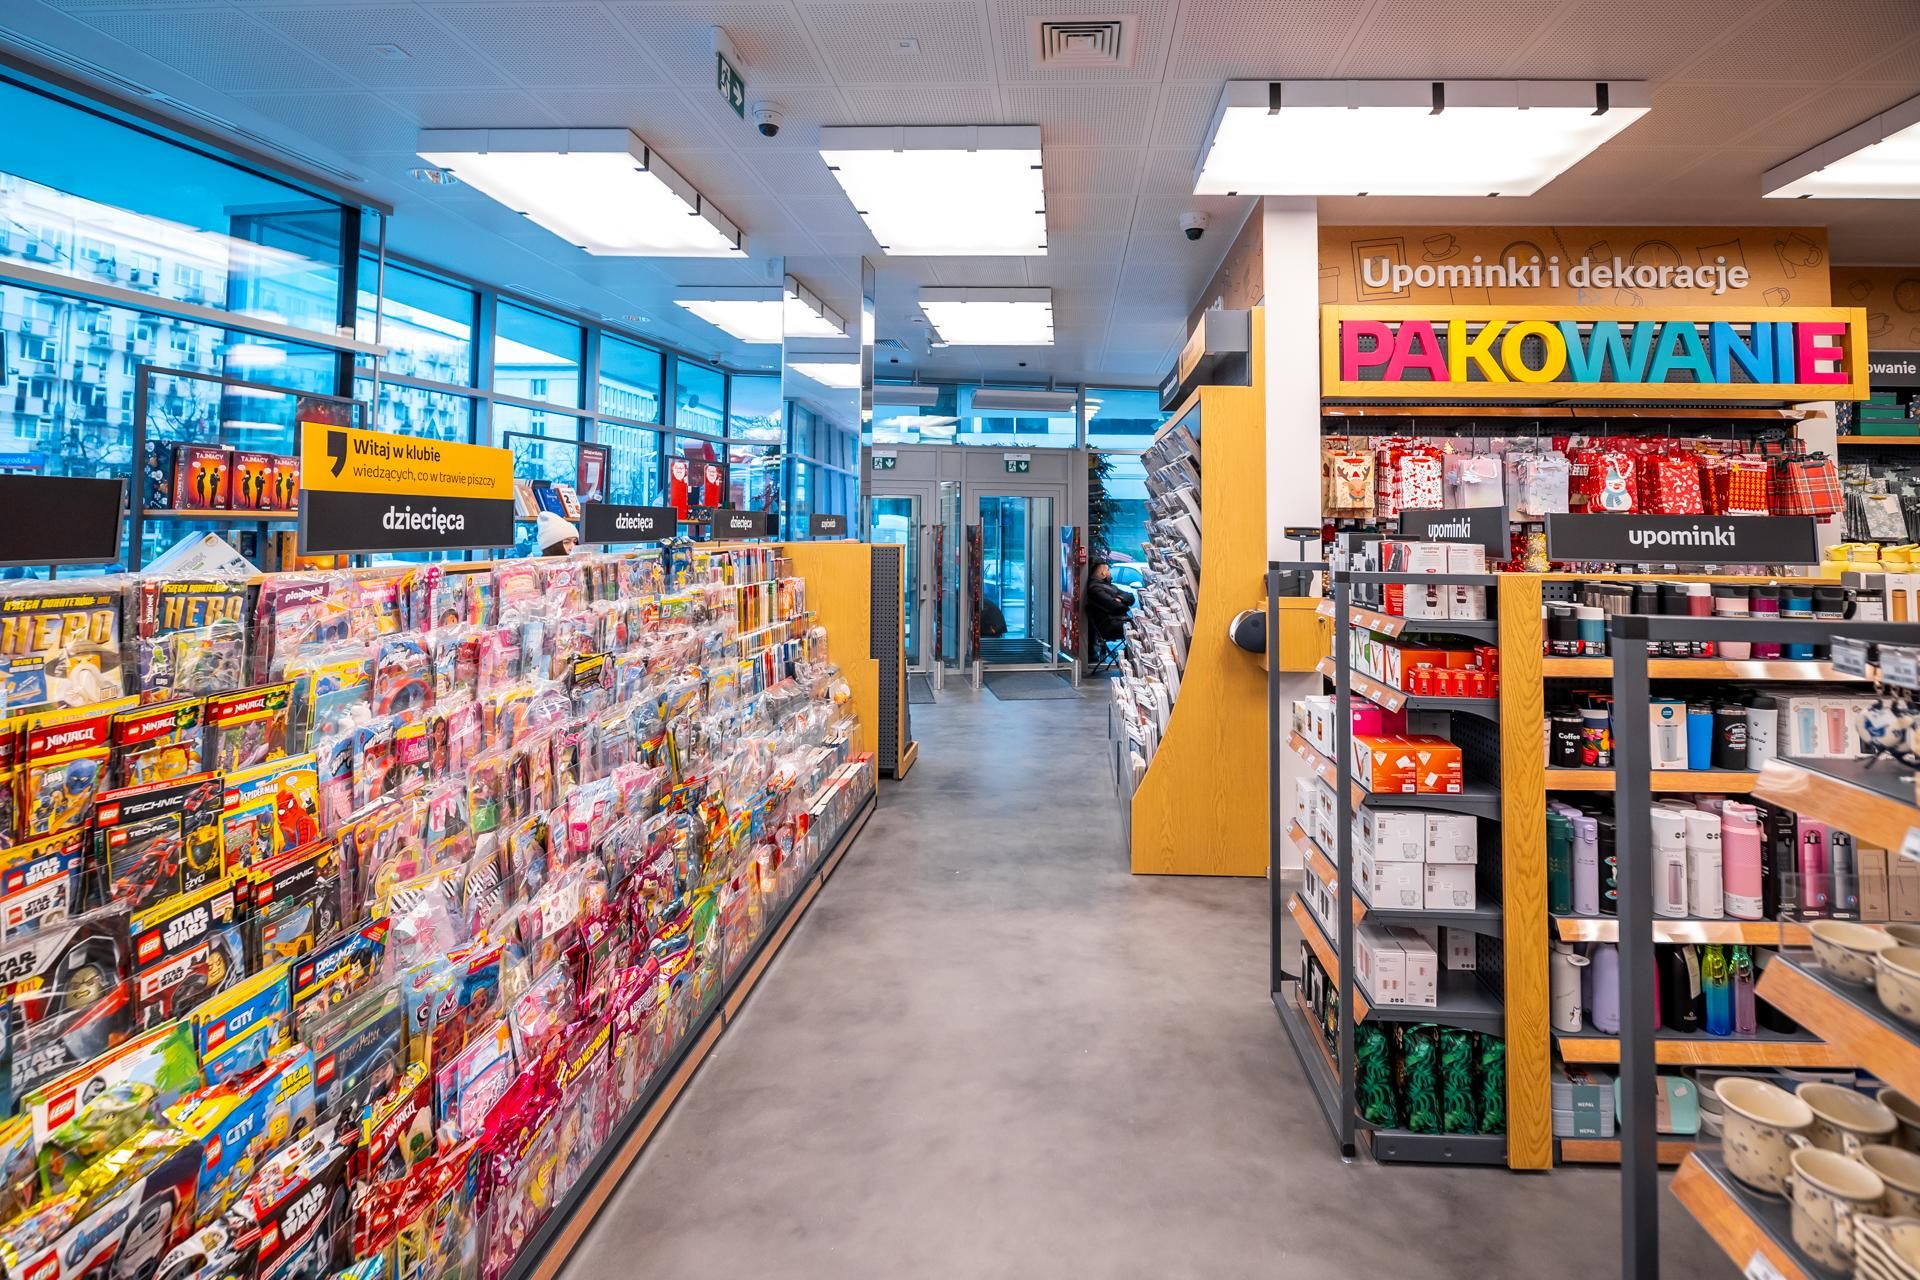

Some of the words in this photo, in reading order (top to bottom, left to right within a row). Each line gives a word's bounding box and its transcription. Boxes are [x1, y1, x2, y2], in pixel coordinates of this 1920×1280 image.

[1363, 255, 1540, 294] Upominki
[1549, 255, 1559, 288] i
[1569, 255, 1749, 296] dekoracje
[1342, 320, 1849, 385] PAKOWANIE
[1868, 361, 1917, 375] owanie
[353, 438, 390, 461] Witaj
[394, 447, 405, 458] w
[406, 444, 441, 462] klubie
[353, 464, 416, 483] wiedzących,
[417, 471, 429, 482] co
[430, 473, 439, 482] w
[439, 471, 467, 485] trawie
[467, 475, 496, 489] piszczy
[382, 505, 465, 535] dziecięca
[615, 512, 654, 532] dziecięca
[730, 515, 753, 531] dziecięca
[1428, 517, 1471, 542] upominki
[1628, 525, 1737, 549] upominki
[163, 596, 244, 629] HERO
[1, 610, 114, 655] HERO
[45, 727, 96, 751] NINJAGO
[1559, 732, 1580, 741] Coffee
[100, 809, 119, 821] LEGO
[123, 796, 184, 815] TECHNIC
[129, 823, 168, 838] TECHNIC
[26, 866, 61, 885] WARS
[29, 857, 61, 875] STAR
[275, 867, 315, 891] TECHNIC
[168, 907, 208, 934] STAR
[163, 918, 208, 951] WARS
[0, 951, 37, 972] TAR
[0, 960, 37, 983] ARS
[229, 1007, 255, 1032] CITY
[49, 1100, 74, 1119] LEGO
[225, 1113, 255, 1145] CITY
[286, 1184, 328, 1219] STAR
[280, 1197, 324, 1241] WARS
